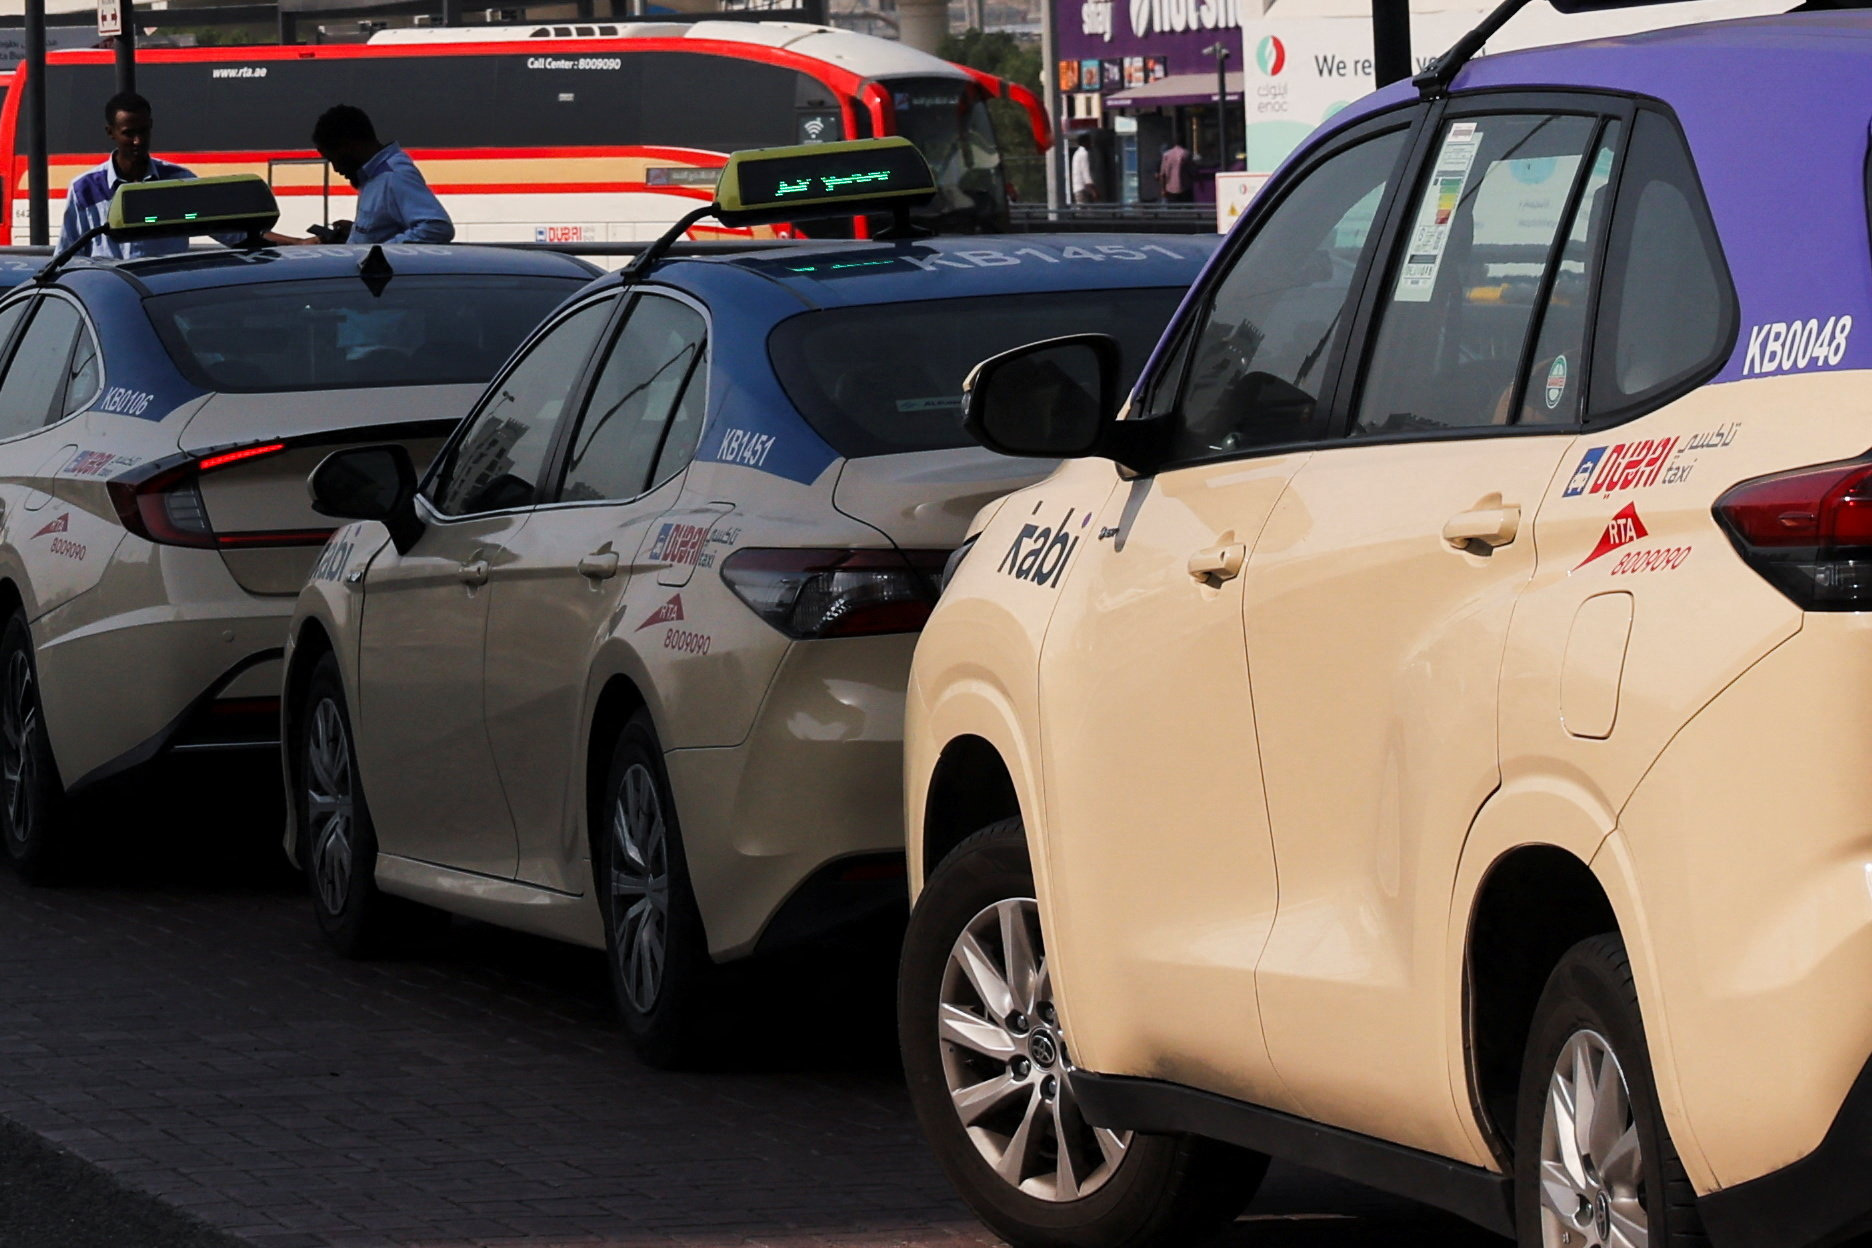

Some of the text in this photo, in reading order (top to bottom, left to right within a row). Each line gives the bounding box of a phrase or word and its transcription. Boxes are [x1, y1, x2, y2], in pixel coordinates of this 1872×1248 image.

[213, 67, 267, 78] www.rta.ae
[527, 57, 544, 69] Call
[578, 58, 621, 70] 8009090
[1314, 55, 1347, 77] We
[1257, 99, 1288, 113] enoc
[548, 227, 583, 242] DUBAI
[899, 241, 1187, 272] KB1451
[1742, 315, 1852, 376] KB0048
[100, 386, 155, 416] KB0106
[716, 428, 777, 467] KB1451
[1589, 436, 1681, 495] DUBAI
[1661, 459, 1698, 485] taxi
[1609, 516, 1637, 544] RTA
[50, 537, 87, 561] 8009090
[1611, 546, 1692, 576] 8009090
[659, 604, 679, 622] RTA
[664, 628, 712, 656] 8009090
